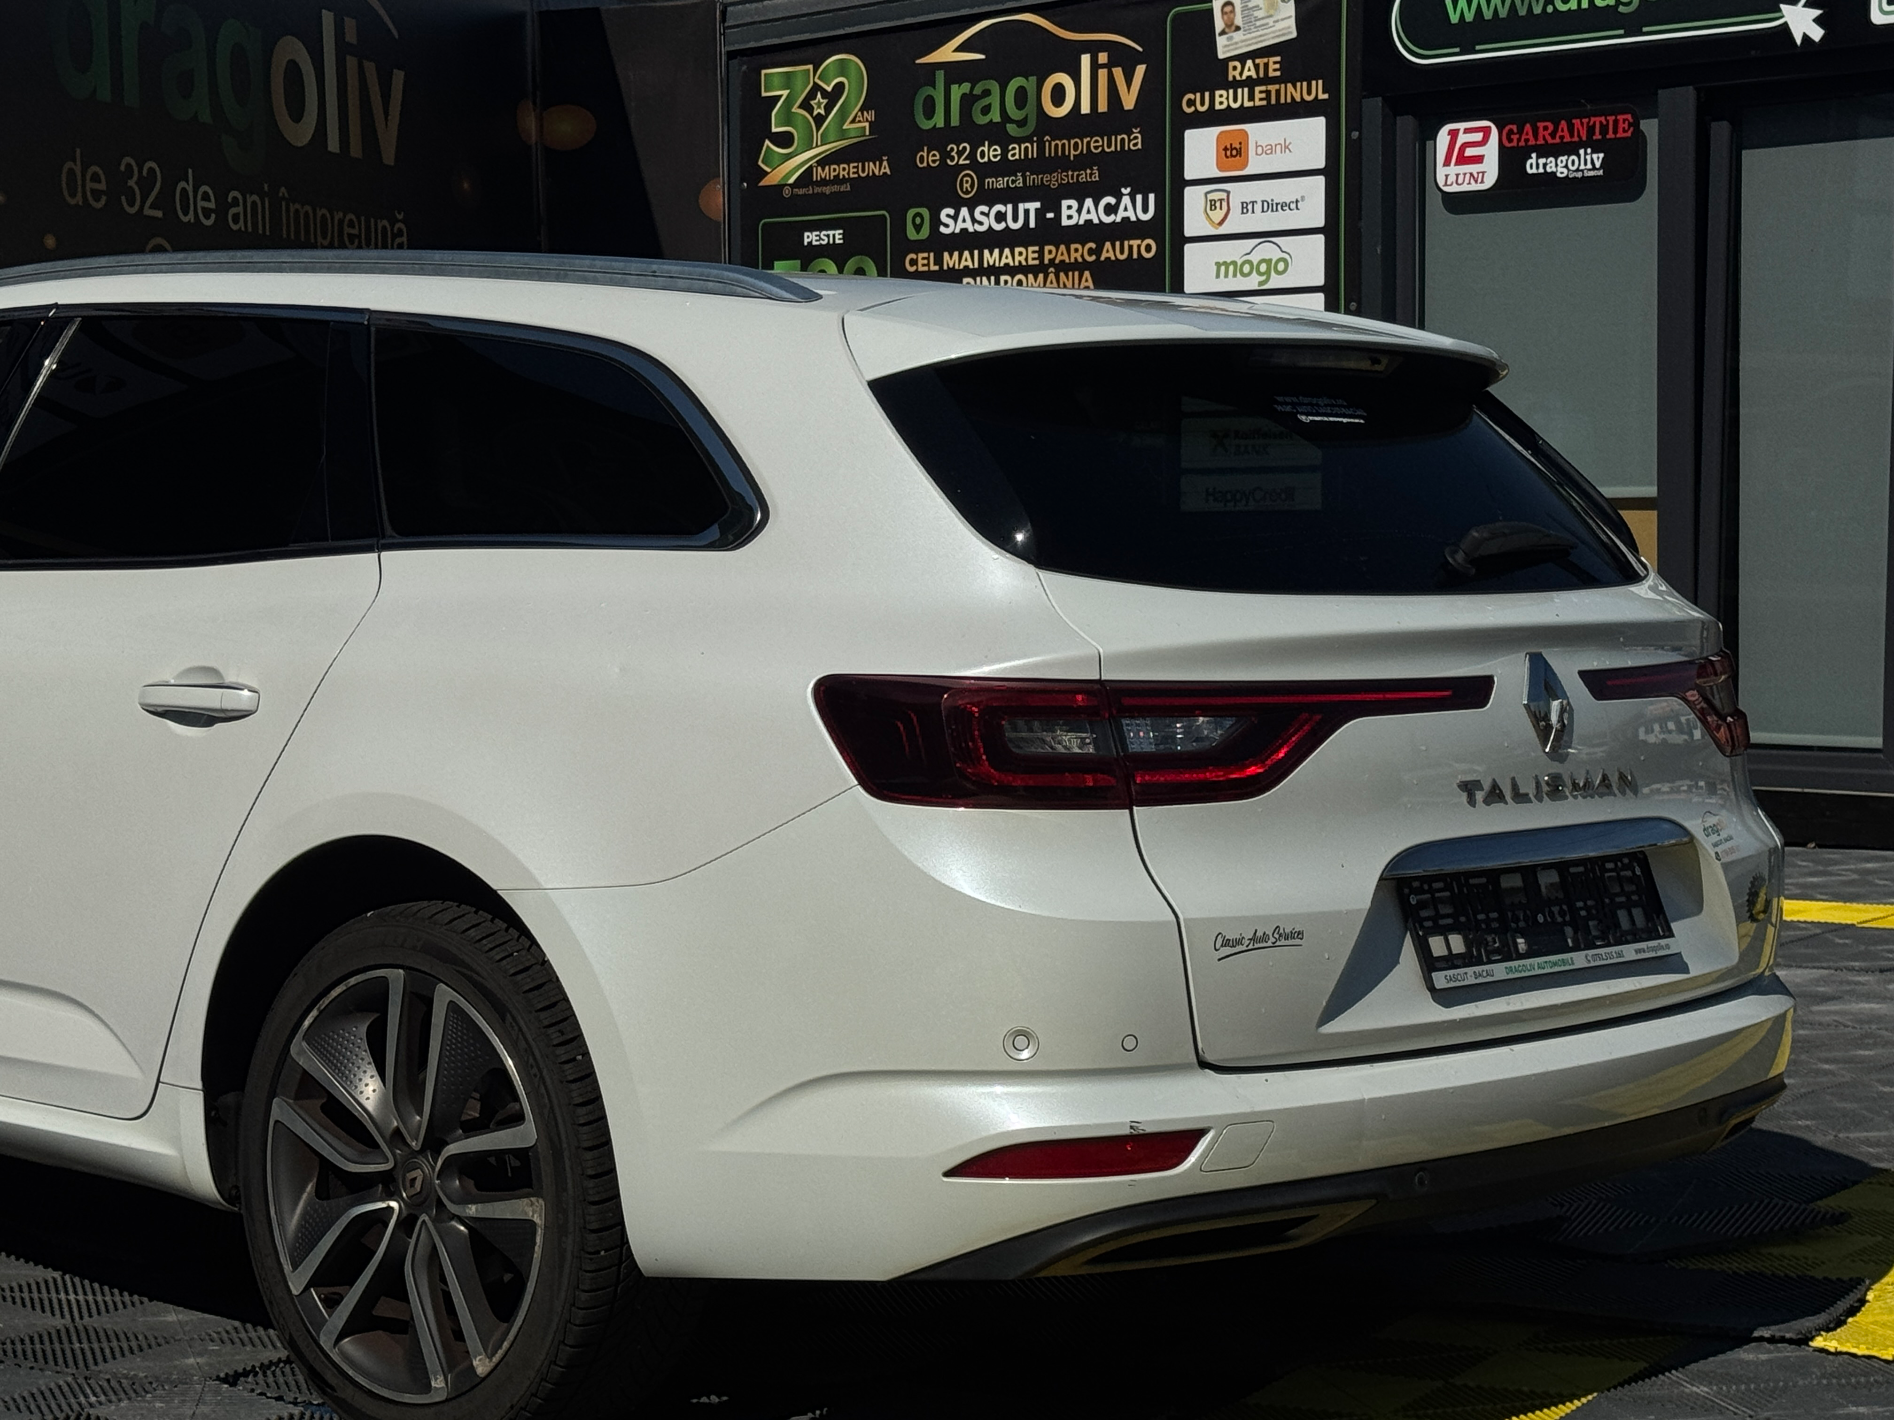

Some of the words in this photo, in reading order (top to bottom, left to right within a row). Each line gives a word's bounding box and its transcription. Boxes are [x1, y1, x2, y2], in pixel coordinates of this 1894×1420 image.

[1228, 56, 1281, 81] RATE
[914, 52, 1147, 137] dragoliv
[1181, 91, 1210, 114] CU
[1215, 80, 1329, 110] BULETINUL
[758, 53, 869, 173] 32
[855, 110, 875, 122] ANI
[1501, 113, 1635, 147] GARANTIE
[916, 146, 940, 168] de
[946, 142, 971, 166] 32
[976, 141, 1001, 163] de
[1007, 137, 1037, 160] ani
[1044, 127, 1143, 161] împreună
[1222, 142, 1243, 159] tbi
[1254, 138, 1292, 157] bank
[1442, 125, 1492, 168] 12
[812, 156, 891, 182] ÎMPREUNĂ
[1526, 148, 1604, 177] dragoliv
[60, 148, 107, 209] de
[119, 155, 164, 219] 32
[175, 168, 217, 227] de
[227, 182, 271, 236] ani
[984, 173, 1023, 190] marcă
[1026, 166, 1099, 189] înregistrată
[1442, 171, 1487, 187] LUNI
[939, 202, 1041, 235] SASCUT
[1061, 187, 1156, 227] BACĂU
[1209, 198, 1226, 212] BT
[1240, 201, 1257, 215] BT
[803, 230, 844, 246] PESTE
[905, 252, 939, 272] CEL
[943, 249, 979, 271] MAI
[983, 246, 1040, 269] MARE
[1044, 242, 1097, 264] PARC
[1101, 238, 1157, 261] AUTO
[1215, 257, 1289, 288] mogo
[1457, 768, 1638, 807] TALISMAN
[1213, 932, 1245, 952] Classic
[1245, 928, 1270, 948] Auto
[1271, 925, 1305, 945] Services
